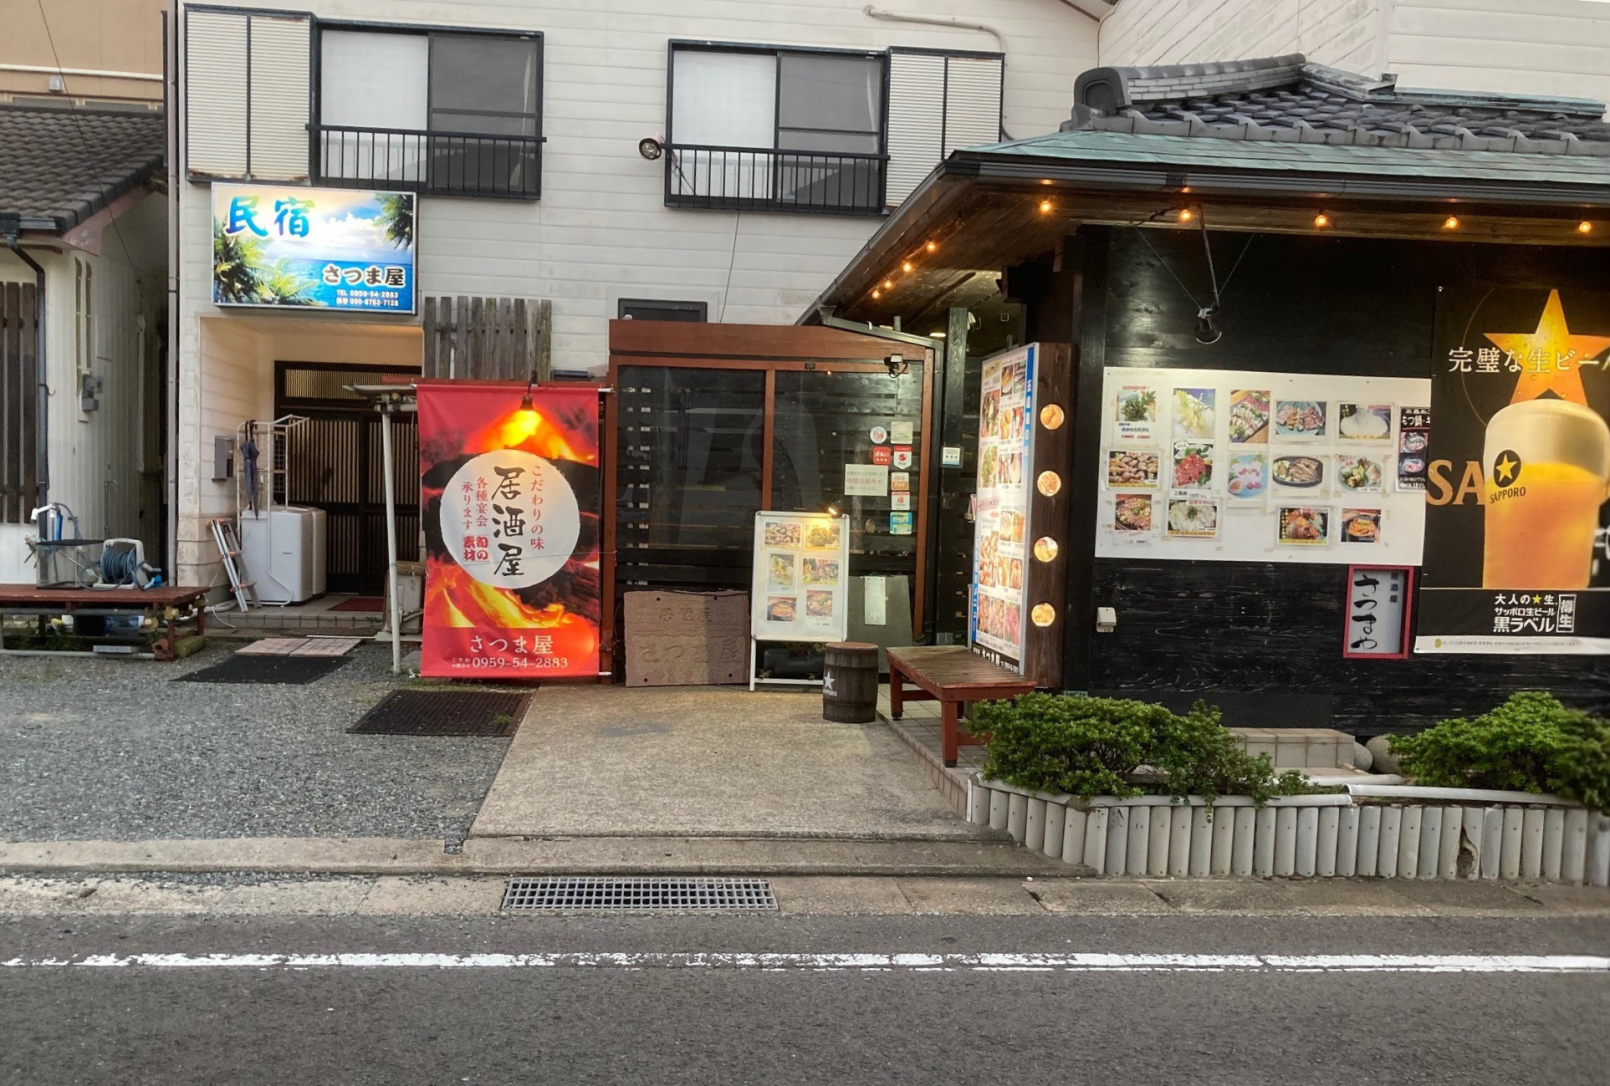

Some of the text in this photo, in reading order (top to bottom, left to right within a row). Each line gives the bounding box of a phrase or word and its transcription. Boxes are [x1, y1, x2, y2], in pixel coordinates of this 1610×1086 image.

[225, 195, 315, 238] 民宿
[323, 264, 405, 287] さつま屋
[336, 289, 348, 297] TEL
[461, 481, 474, 531] 承ります
[475, 476, 488, 527] 各種宴会
[1490, 486, 1526, 504] SAPPORO
[530, 465, 545, 551] こだわりの味
[491, 465, 526, 577] 居酒屋
[1350, 573, 1379, 652] さつまや
[1494, 607, 1556, 616] サッポロ生ビール
[1493, 616, 1555, 633] 黒ラベル
[470, 635, 554, 654] さつま屋
[472, 657, 568, 668] 0959-54-2883
